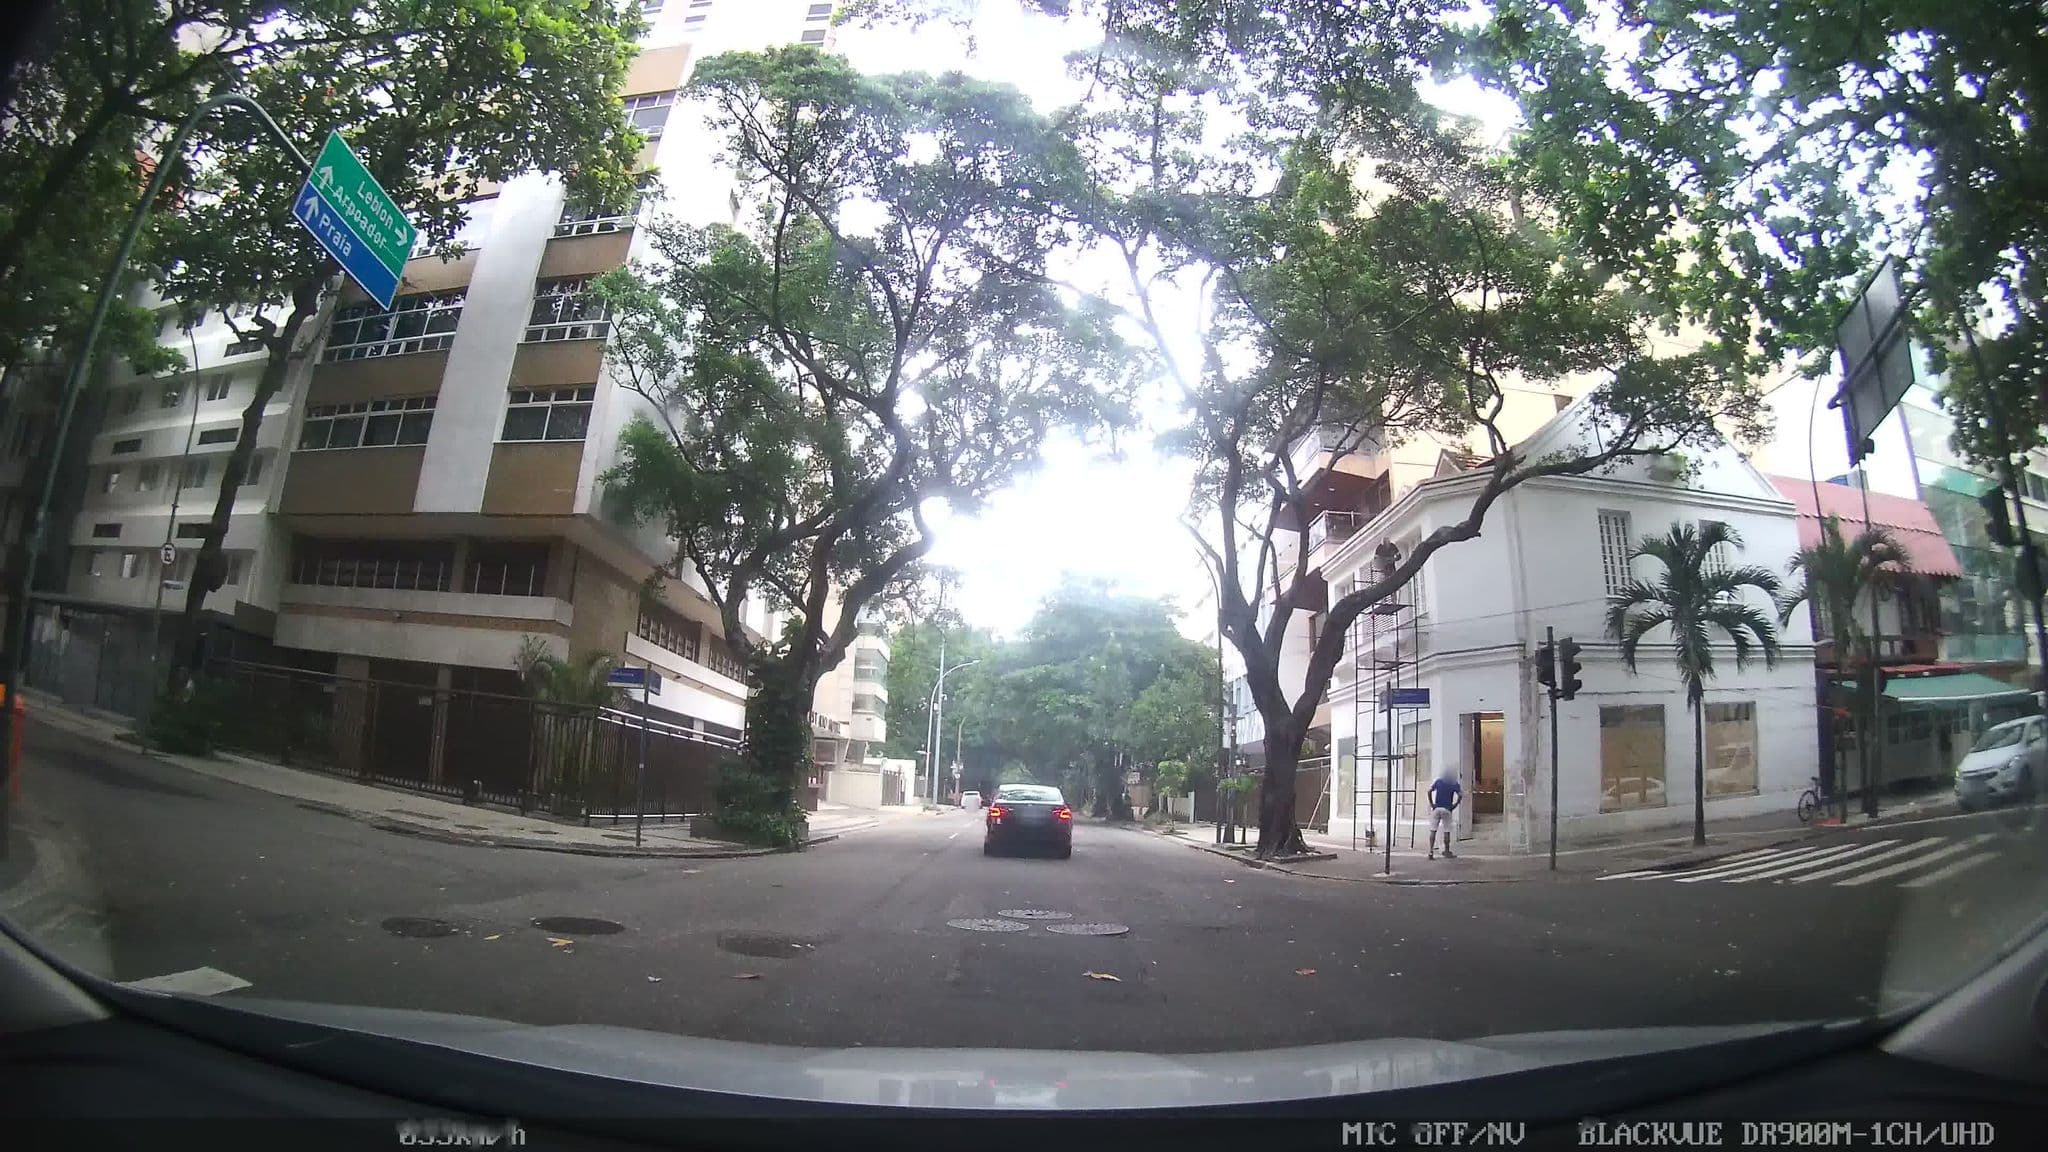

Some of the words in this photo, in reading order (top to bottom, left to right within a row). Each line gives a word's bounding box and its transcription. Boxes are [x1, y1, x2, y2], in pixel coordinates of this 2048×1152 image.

[332, 186, 387, 249] Arpoador
[357, 181, 393, 230] Leblon
[318, 213, 352, 257] Praia
